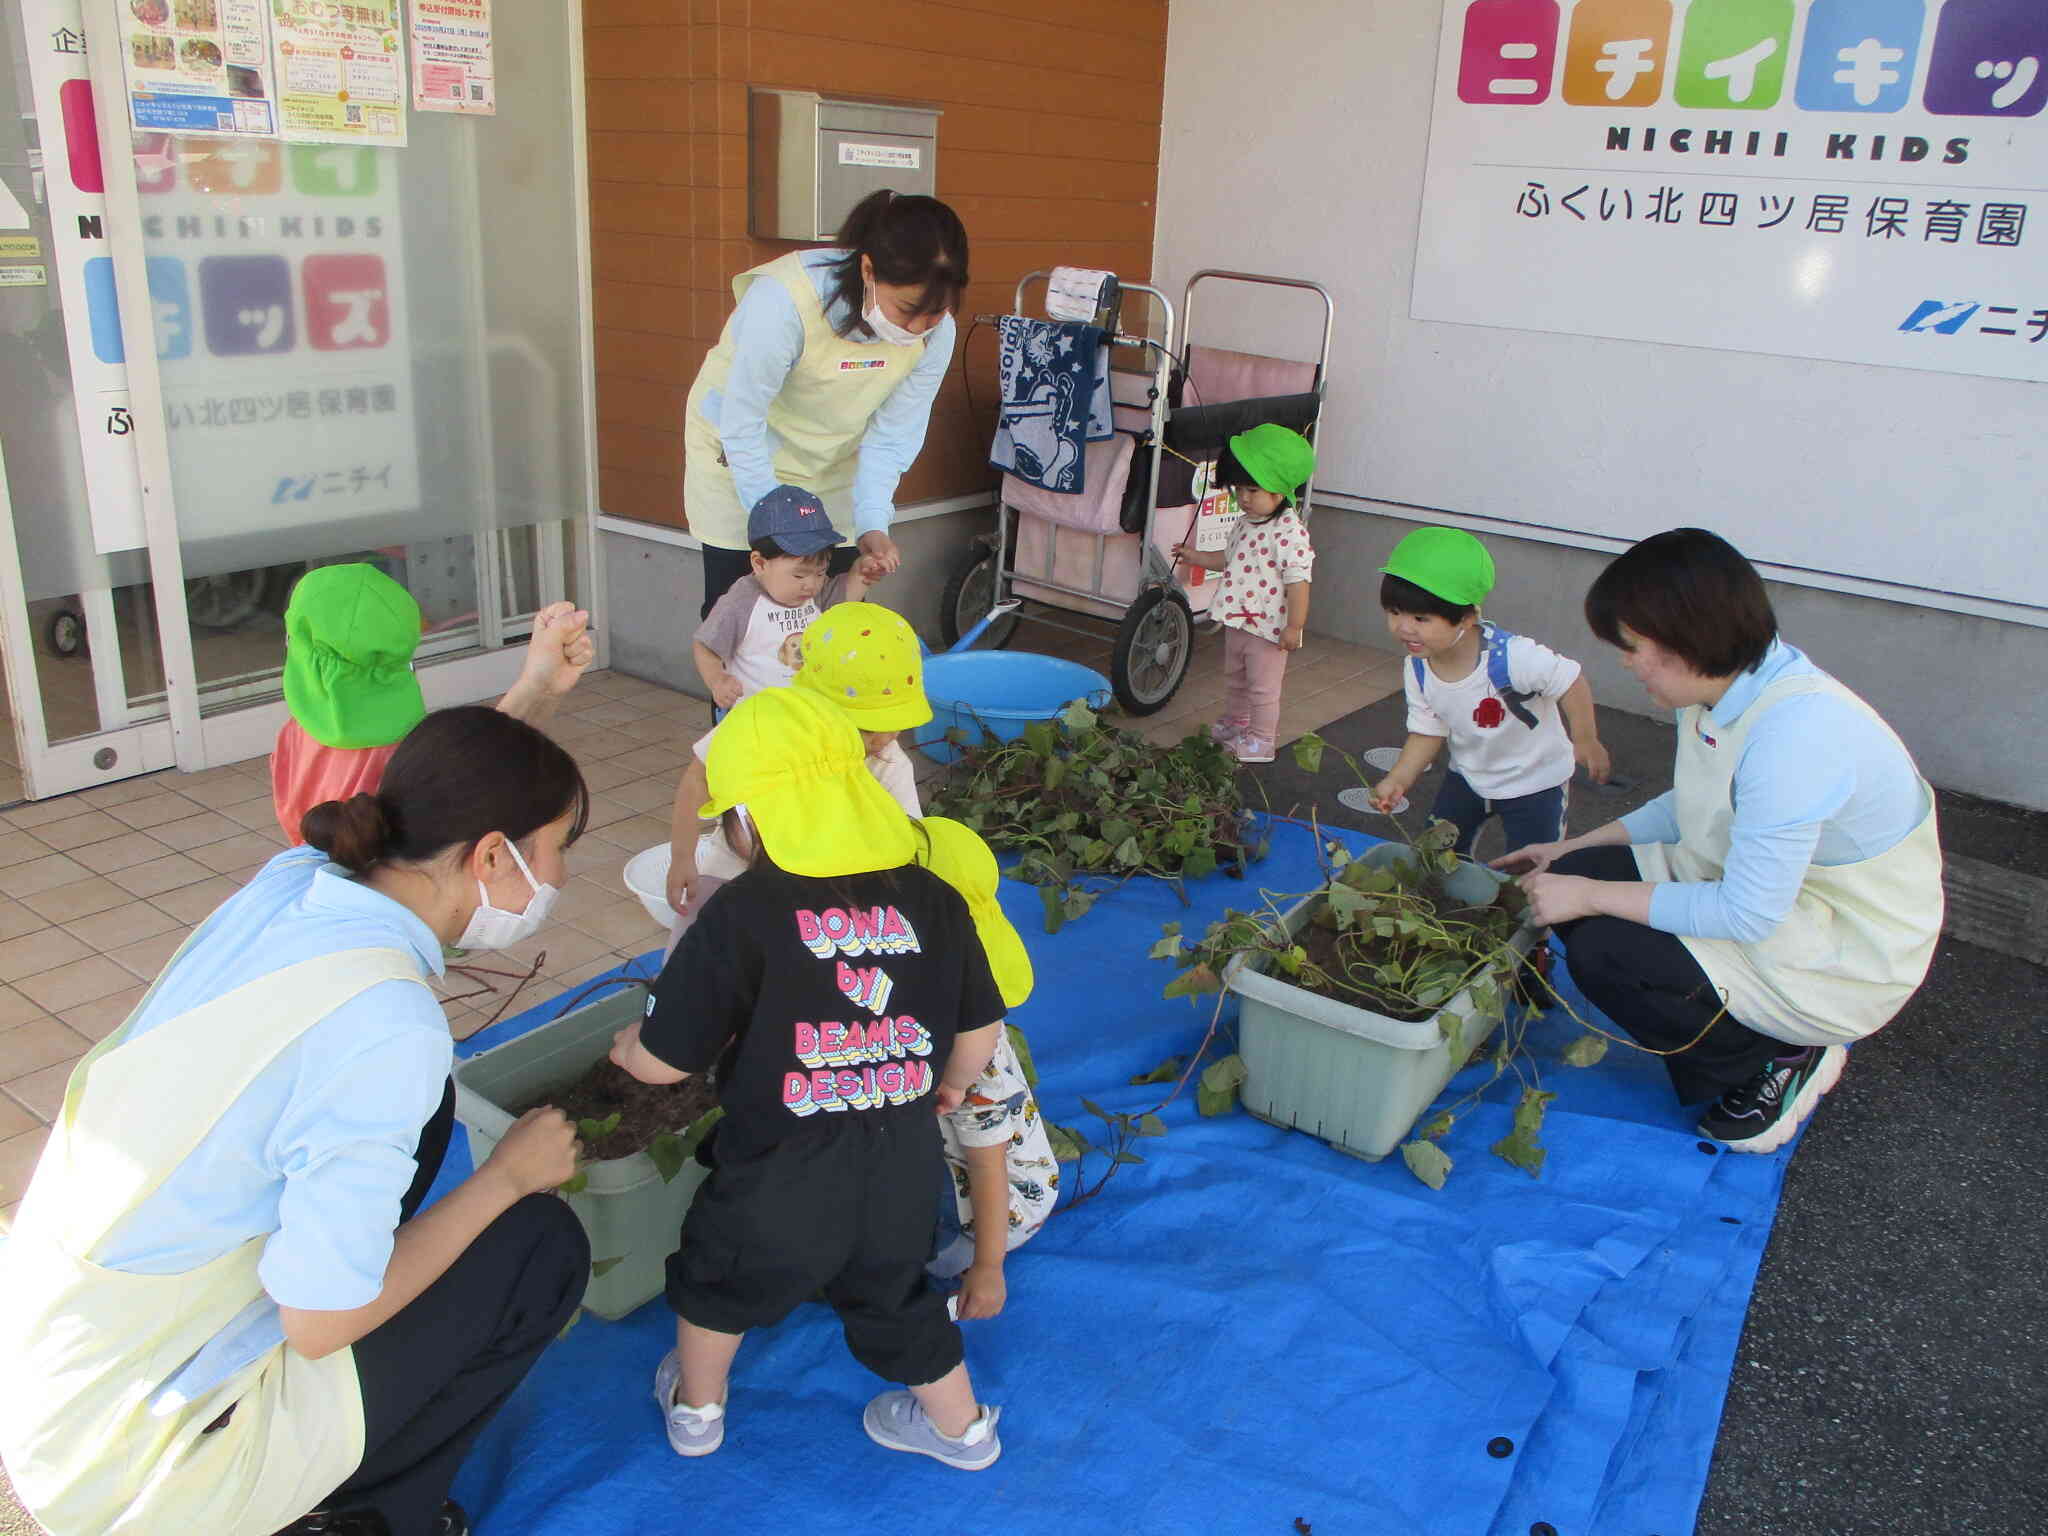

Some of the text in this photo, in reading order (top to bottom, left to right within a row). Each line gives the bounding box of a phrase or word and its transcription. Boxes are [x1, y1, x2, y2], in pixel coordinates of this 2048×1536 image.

[1606, 127, 1972, 165] NICHII KIDS
[281, 215, 382, 239] KIDS
[1516, 182, 2028, 248] ふくい北四ツ居保育園
[768, 611, 780, 623] MY
[795, 905, 920, 956] BOWA
[836, 961, 891, 1012] by
[795, 1015, 931, 1066] BEAMS
[783, 1060, 933, 1114] DESIGN
